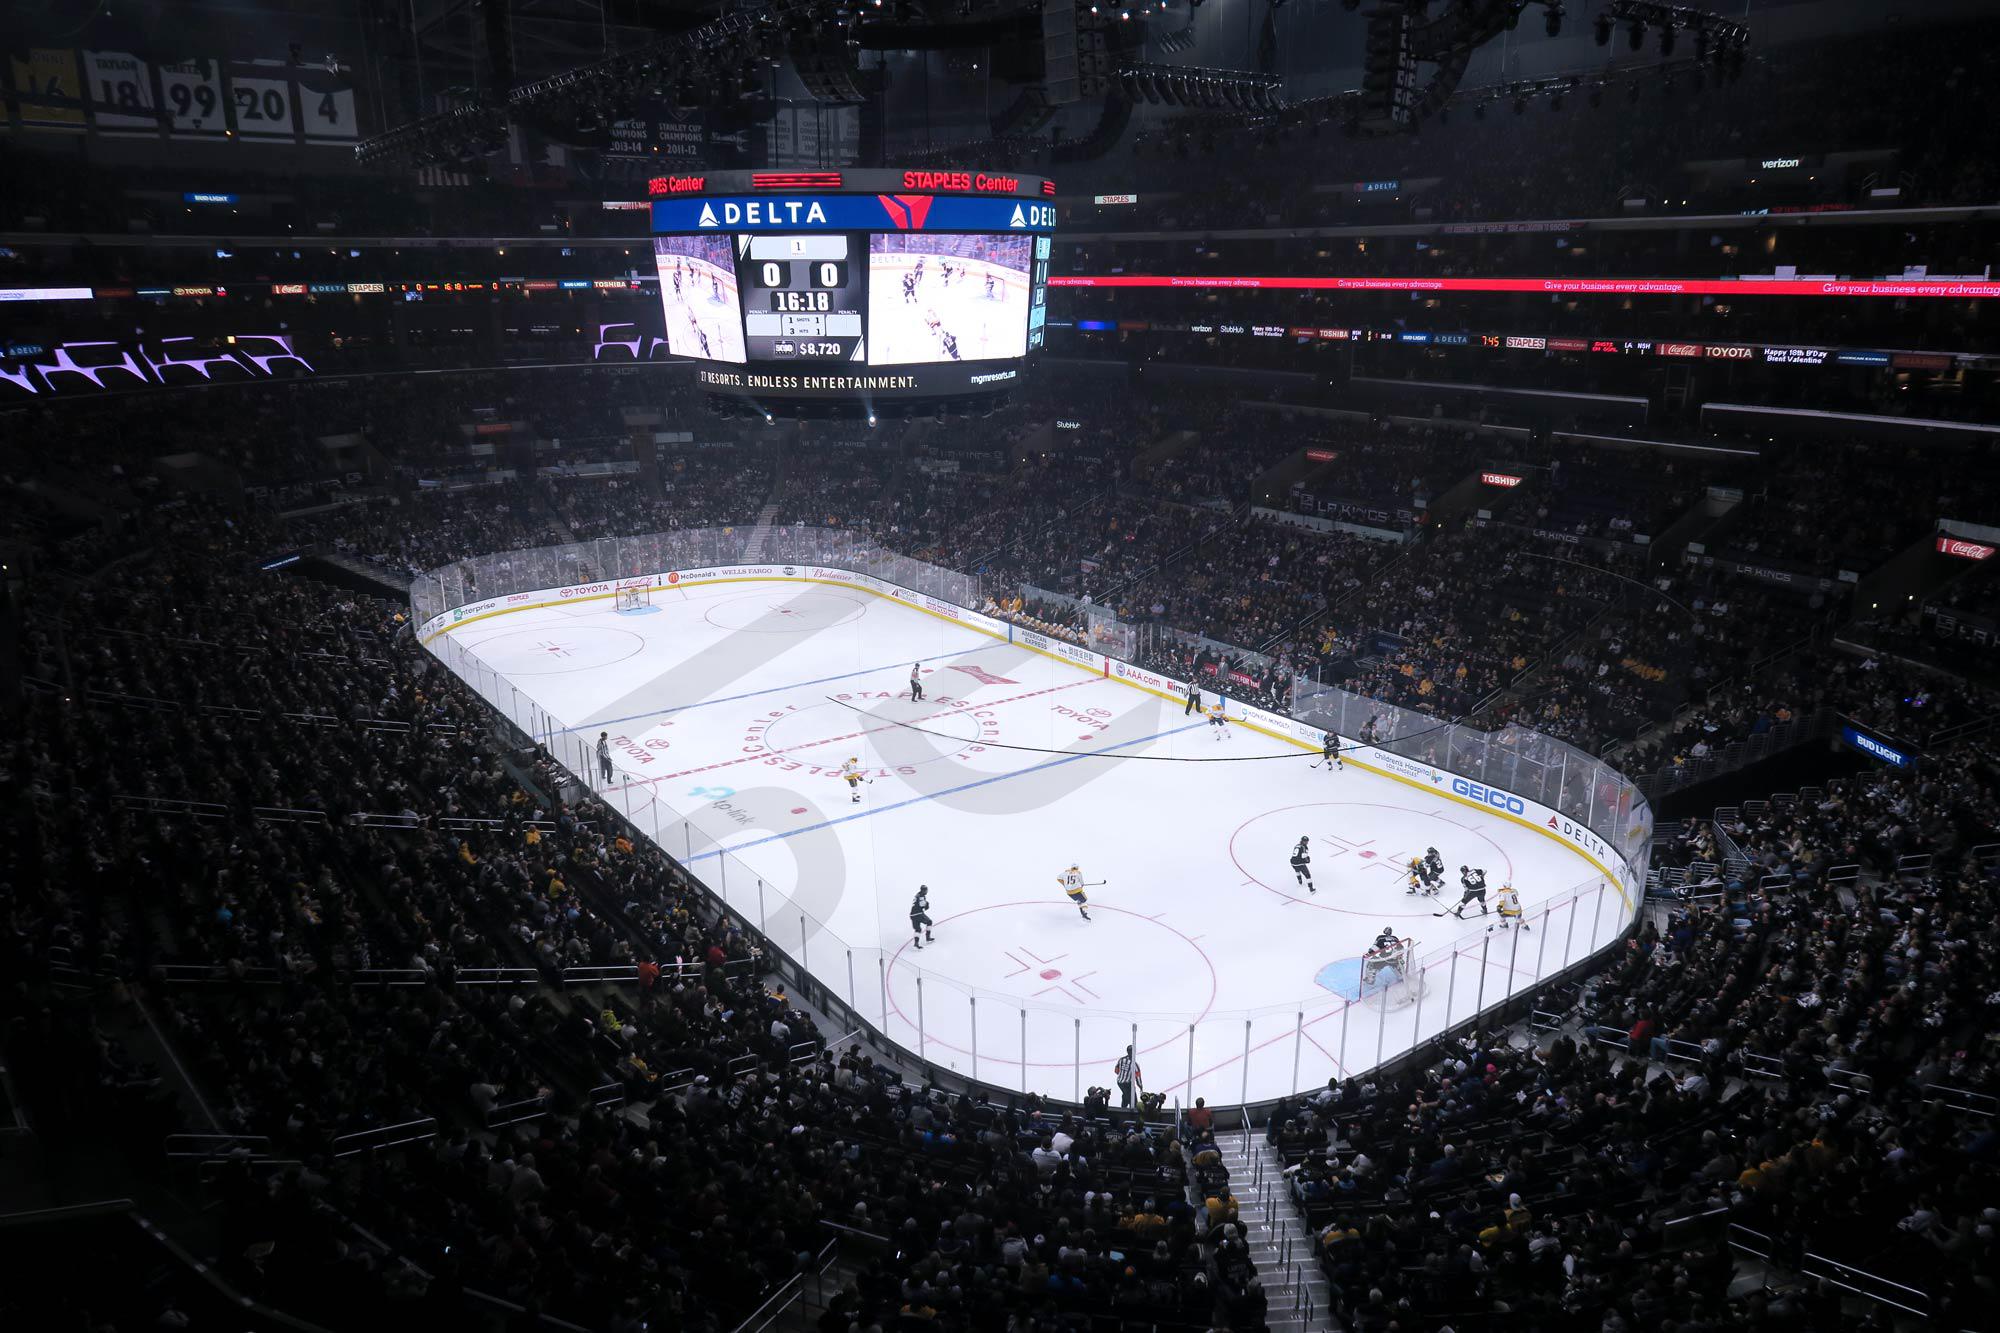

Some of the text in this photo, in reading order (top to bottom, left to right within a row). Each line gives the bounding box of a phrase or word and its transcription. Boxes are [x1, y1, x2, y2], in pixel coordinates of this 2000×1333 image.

[102, 79, 137, 110] 18
[170, 83, 217, 117] 99
[234, 87, 286, 121] 20
[318, 93, 339, 124] 4
[658, 121, 703, 137] STANLEY CUP
[658, 132, 704, 145] CHAMPIONS
[666, 144, 697, 156] 2011-12
[1762, 158, 1799, 168] verizon
[669, 176, 704, 191] Center
[903, 172, 1018, 192] STAPLES Center
[724, 201, 828, 224] DELTA
[763, 262, 781, 287] 0
[820, 262, 838, 287] 0
[349, 284, 384, 292] STAPLES
[1352, 281, 1365, 289] your
[1366, 280, 1391, 288] business
[1544, 281, 1562, 289] Give
[1563, 283, 1580, 292] your
[1581, 281, 1615, 291] business
[1616, 284, 1638, 292] every
[1822, 283, 1847, 293] Give
[1848, 286, 1871, 295] your
[1871, 284, 1916, 294] business
[1917, 286, 1946, 296] every
[184, 288, 214, 296] TOYOTA
[777, 292, 829, 311] 16:18
[1191, 324, 1213, 332] verizon
[1220, 325, 1245, 333] StubHub
[1320, 329, 1349, 338] TOSHIBA
[1441, 336, 1468, 344] DELTA
[1507, 337, 1545, 348] STAPLES
[16, 345, 44, 354] DELTA
[805, 343, 842, 356] $8,720
[1705, 347, 1753, 358] TOYOTA
[1764, 348, 1788, 358] Happy
[1766, 355, 1823, 364] Brent Valentine
[708, 373, 744, 386] RESORTS.
[748, 376, 798, 388] ENDLESS
[803, 376, 918, 389] ENTERTAINMENT.
[1548, 532, 1580, 543] KINGS
[680, 572, 717, 581] McDonald's
[721, 568, 747, 577] WELLS
[748, 568, 773, 576] FARGO
[813, 568, 853, 583] Budweiser
[1736, 564, 1792, 582] LA KINGS
[574, 585, 609, 597] TOYOTA
[508, 594, 530, 603] STAPLES
[1021, 630, 1048, 644] AMERICAN
[1024, 638, 1049, 651] EXPRESS
[1126, 668, 1161, 688] AAA.com
[1050, 705, 1109, 731] TOYOTA
[742, 704, 799, 754] Center
[957, 710, 1001, 761] Center
[1299, 726, 1317, 739] blue
[611, 735, 656, 765] TOYOTA
[1856, 734, 1902, 765] BUD LIGHT
[1374, 751, 1432, 777] Children's Hospital
[1452, 778, 1524, 815] GEICO
[713, 799, 757, 825] tp-link
[1564, 822, 1605, 859] DELTA
[1067, 875, 1076, 885] 15
